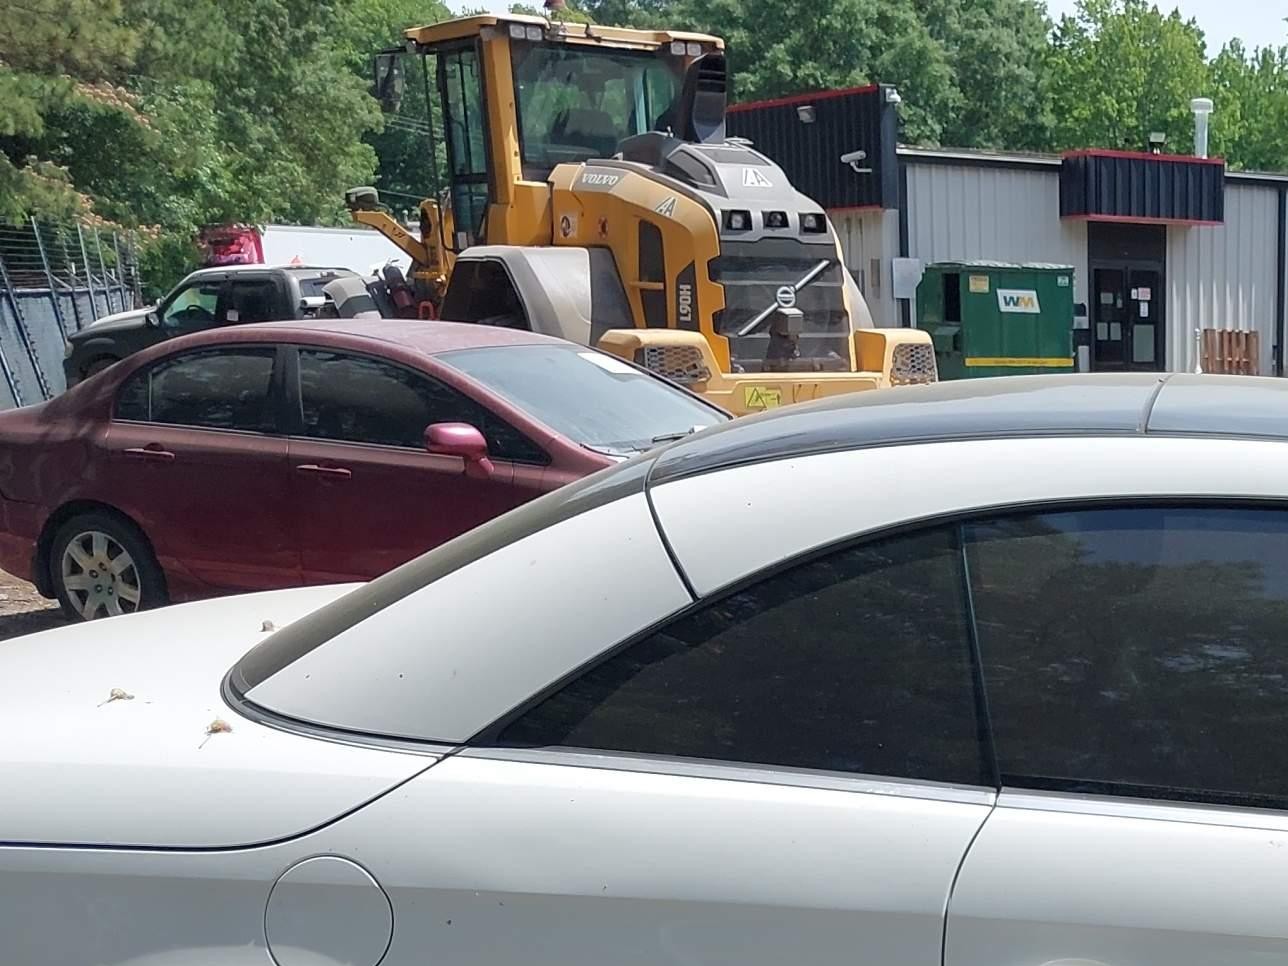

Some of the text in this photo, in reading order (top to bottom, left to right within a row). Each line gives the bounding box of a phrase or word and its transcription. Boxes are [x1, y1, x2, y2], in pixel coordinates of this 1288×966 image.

[582, 174, 618, 185] VOLVO
[680, 285, 691, 322] L90H
[1003, 296, 1035, 308] WM
